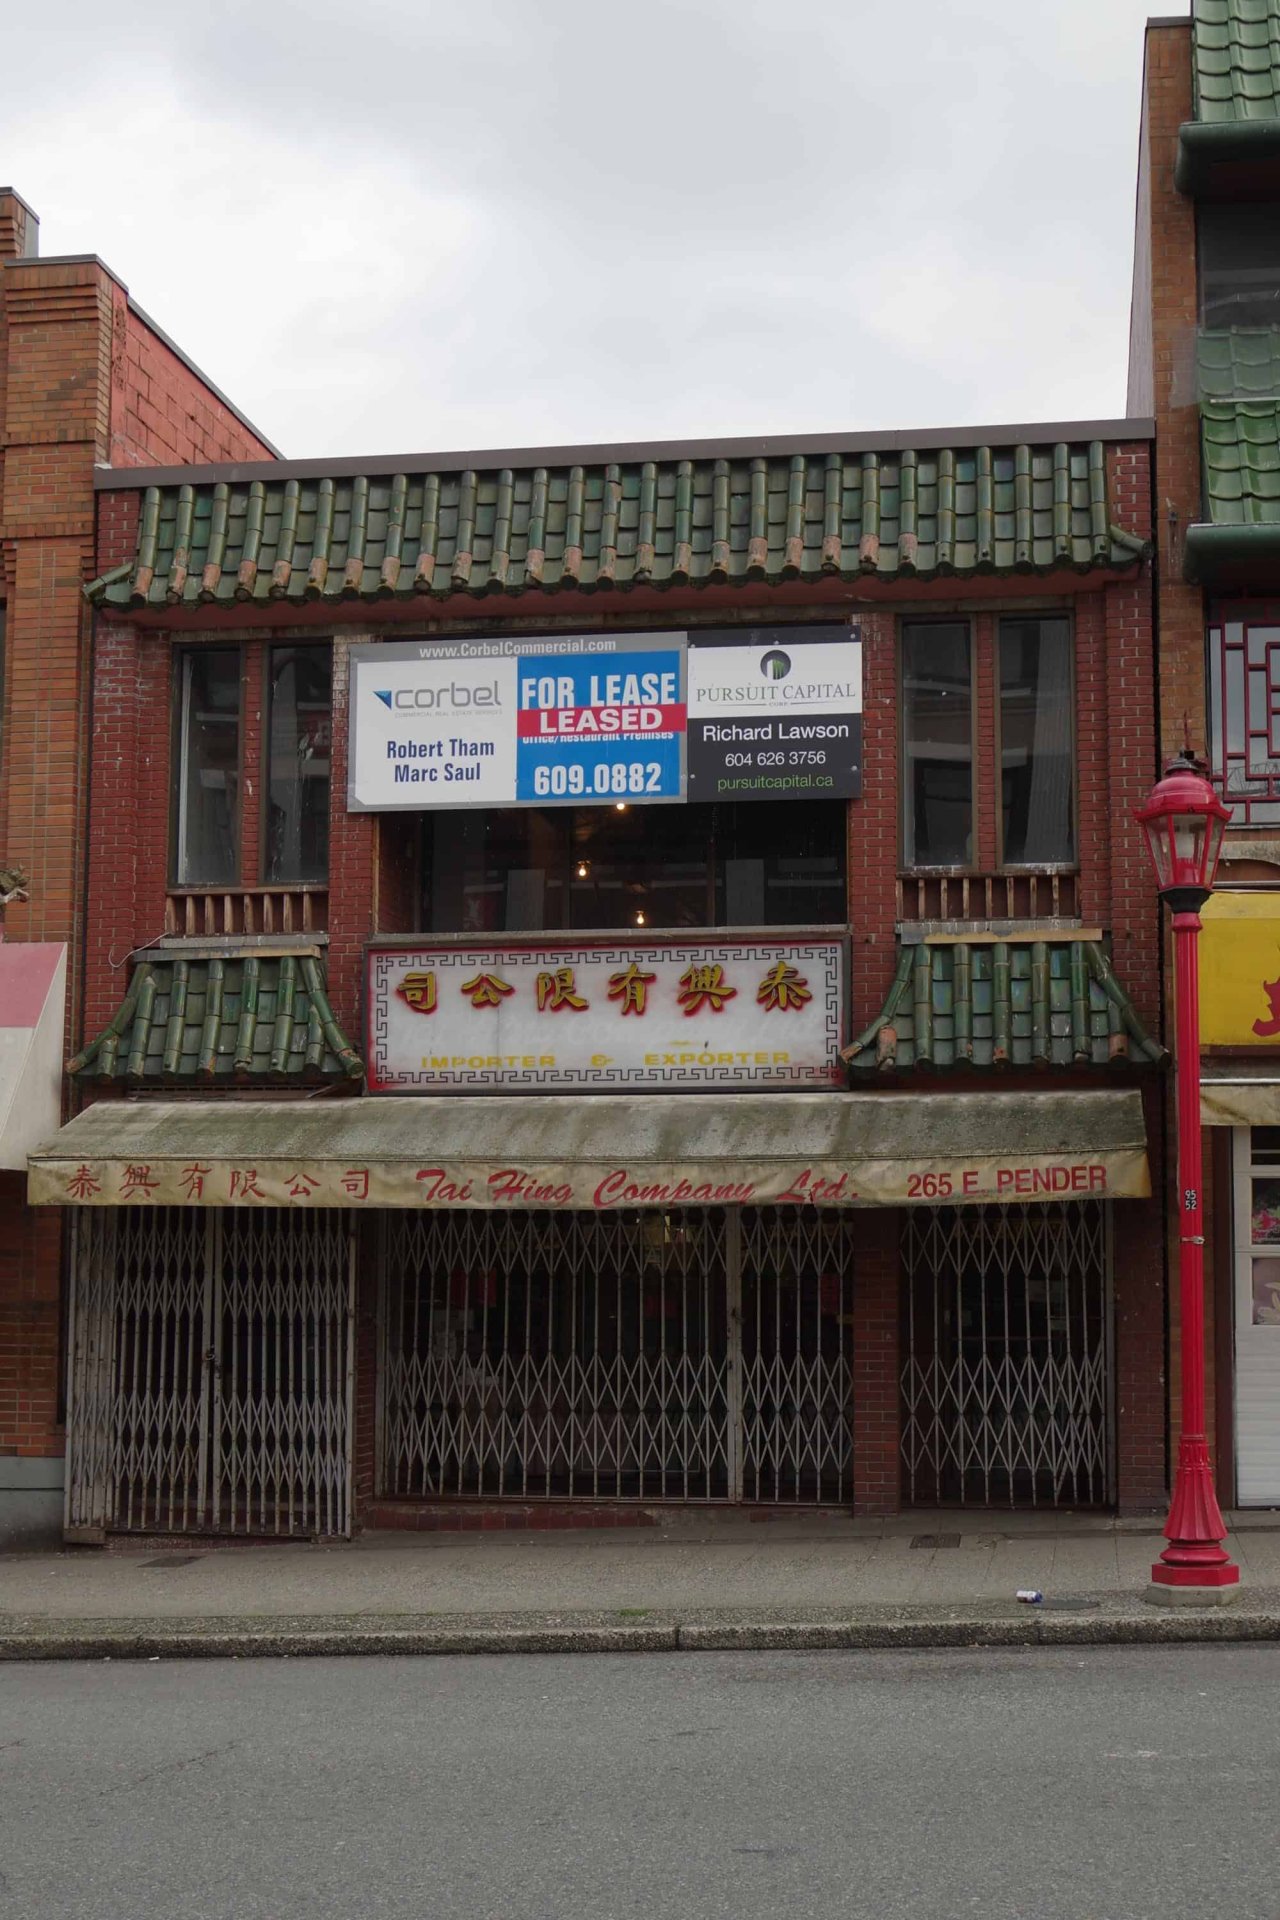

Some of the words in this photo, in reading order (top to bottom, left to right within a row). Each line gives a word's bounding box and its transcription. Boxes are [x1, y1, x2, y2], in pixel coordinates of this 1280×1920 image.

[419, 639, 616, 658] www.CorbelCommercial.com
[395, 680, 502, 709] corbel
[521, 676, 575, 710] FOR
[590, 673, 675, 707] LEASE
[696, 686, 778, 702] PURSUIT
[782, 683, 856, 699] CAPITAL
[540, 708, 663, 734] LEASED
[703, 724, 772, 742] Richard
[778, 723, 849, 739] Lawson
[387, 740, 443, 759] Robert
[449, 738, 495, 757] Tham
[725, 753, 752, 767] 604
[757, 752, 785, 766] 626
[788, 750, 827, 765] 3756
[394, 765, 438, 783] Marc
[444, 762, 481, 781] Saul
[534, 763, 661, 796] 609.0882
[717, 773, 834, 792] pursuitcapital.ca
[421, 1055, 556, 1069] IMPORTER
[644, 1051, 791, 1066] EXPORTER
[416, 1168, 474, 1202] Tai
[487, 1168, 575, 1206] Hing
[592, 1169, 757, 1209] Company
[776, 1168, 859, 1204] Ltd.
[907, 1172, 952, 1198] 265
[962, 1170, 987, 1197] E.
[996, 1164, 1108, 1195] PENDER
[1184, 1189, 1197, 1200] 95
[1185, 1199, 1197, 1210] 52
